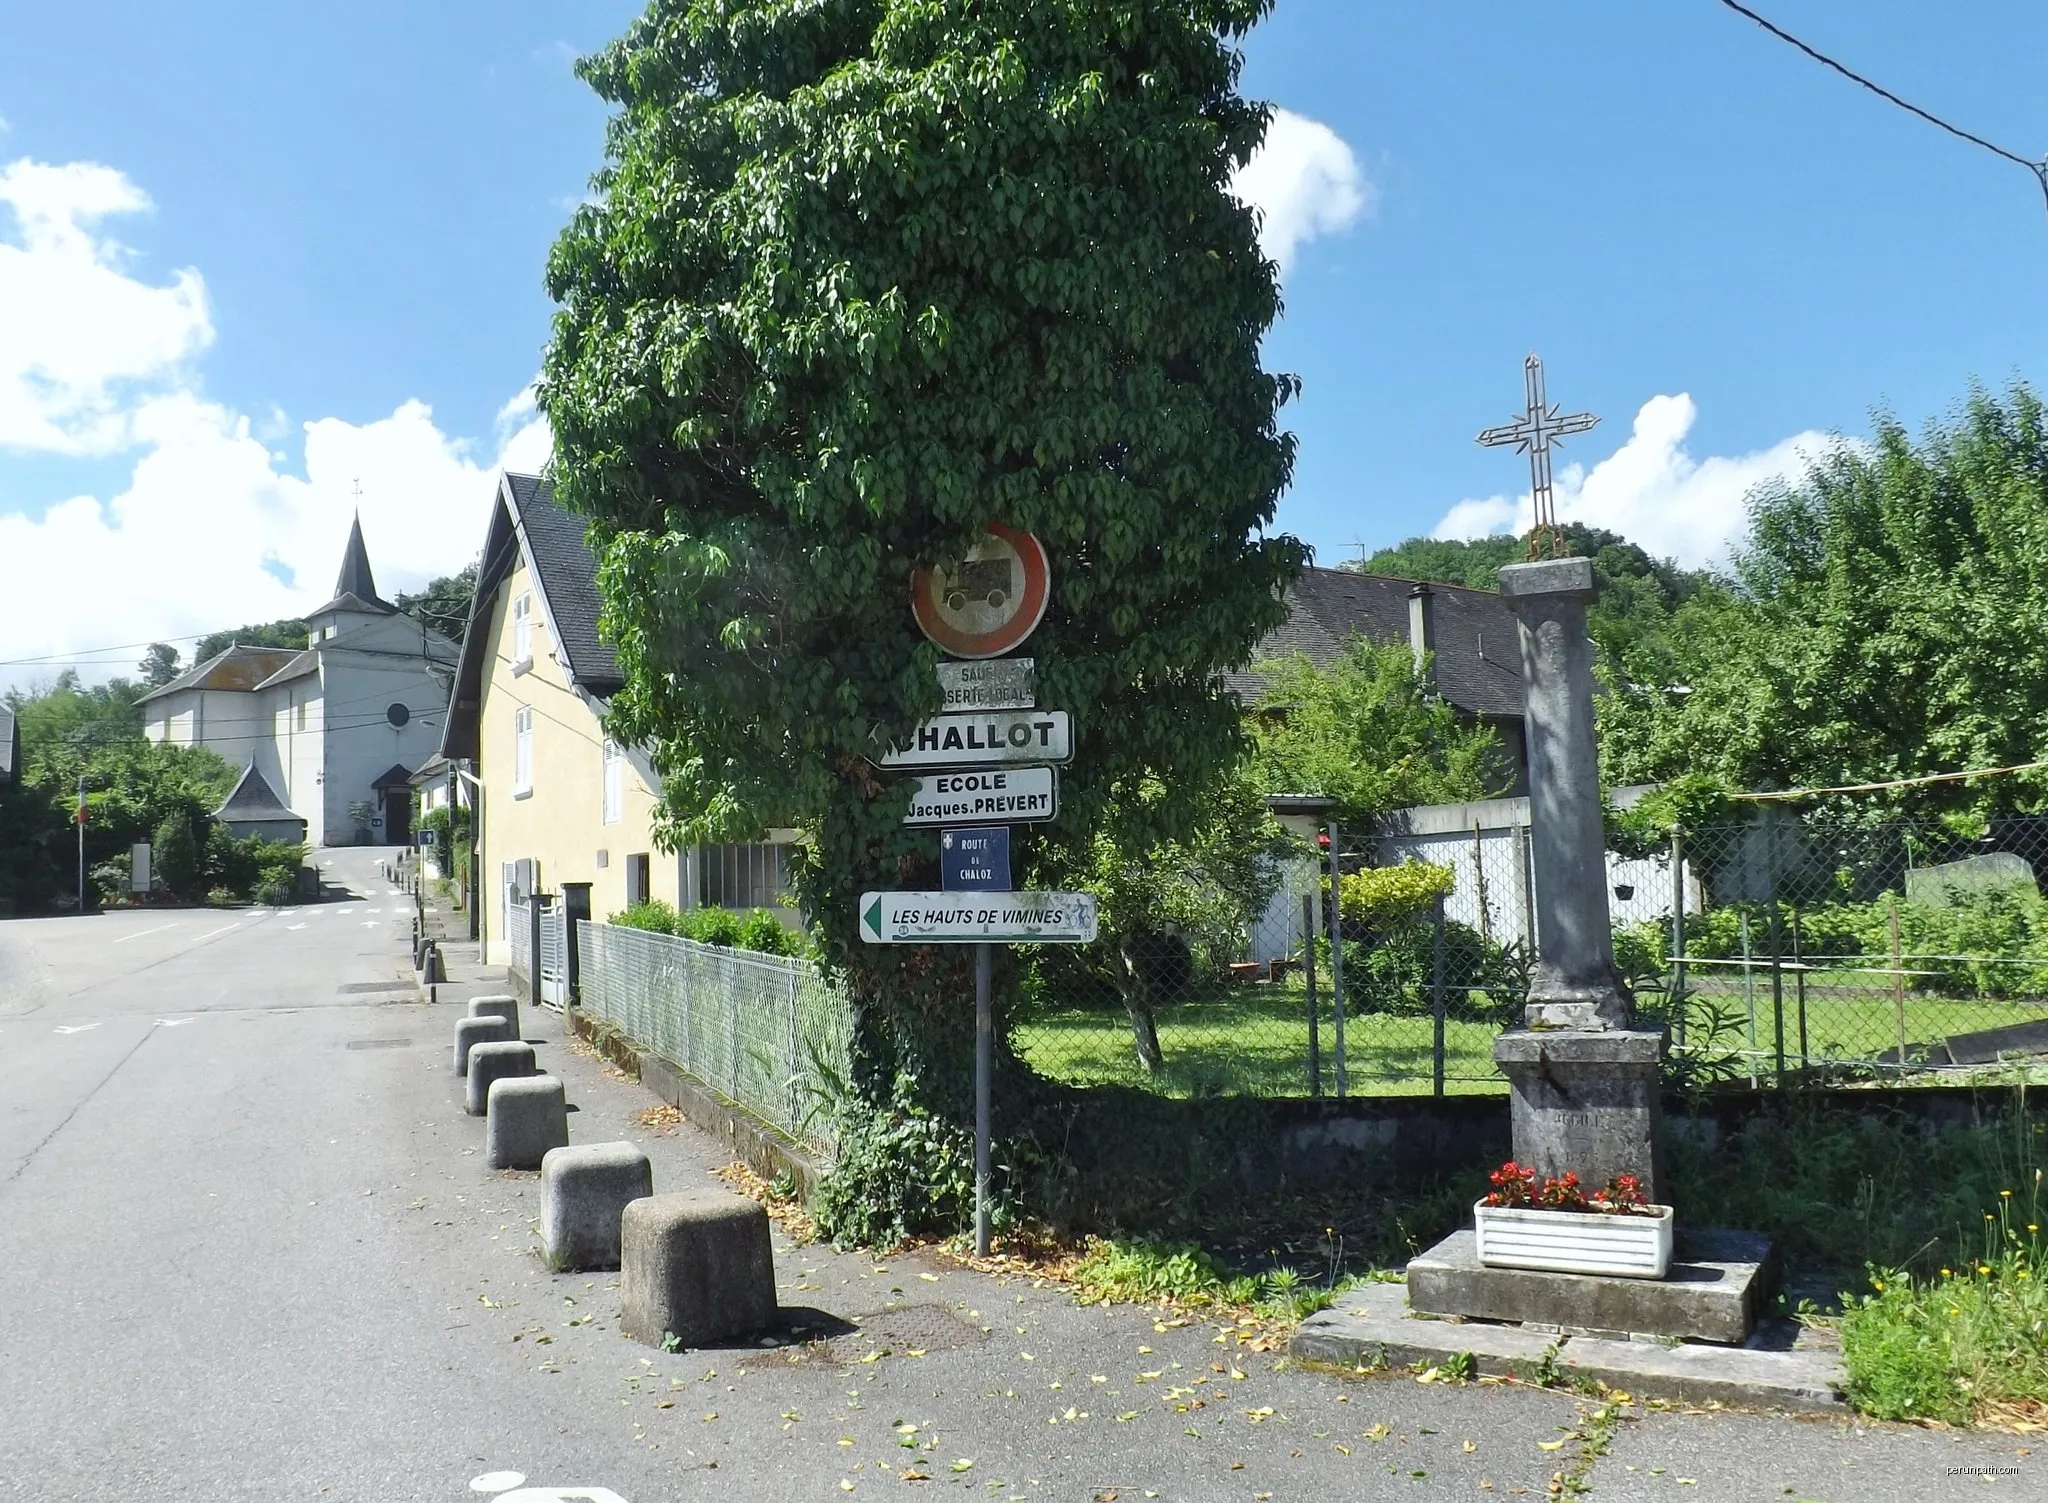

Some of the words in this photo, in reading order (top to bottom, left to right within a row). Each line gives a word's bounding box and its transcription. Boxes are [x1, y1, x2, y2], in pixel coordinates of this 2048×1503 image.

[936, 774, 1007, 793] ECOLE
[961, 839, 988, 850] ROUTE
[960, 869, 992, 880] CHALOZ
[892, 910, 920, 924] LES
[923, 910, 973, 924] HAUTS
[976, 910, 998, 924] DE
[1002, 910, 1063, 924] VIMINES
